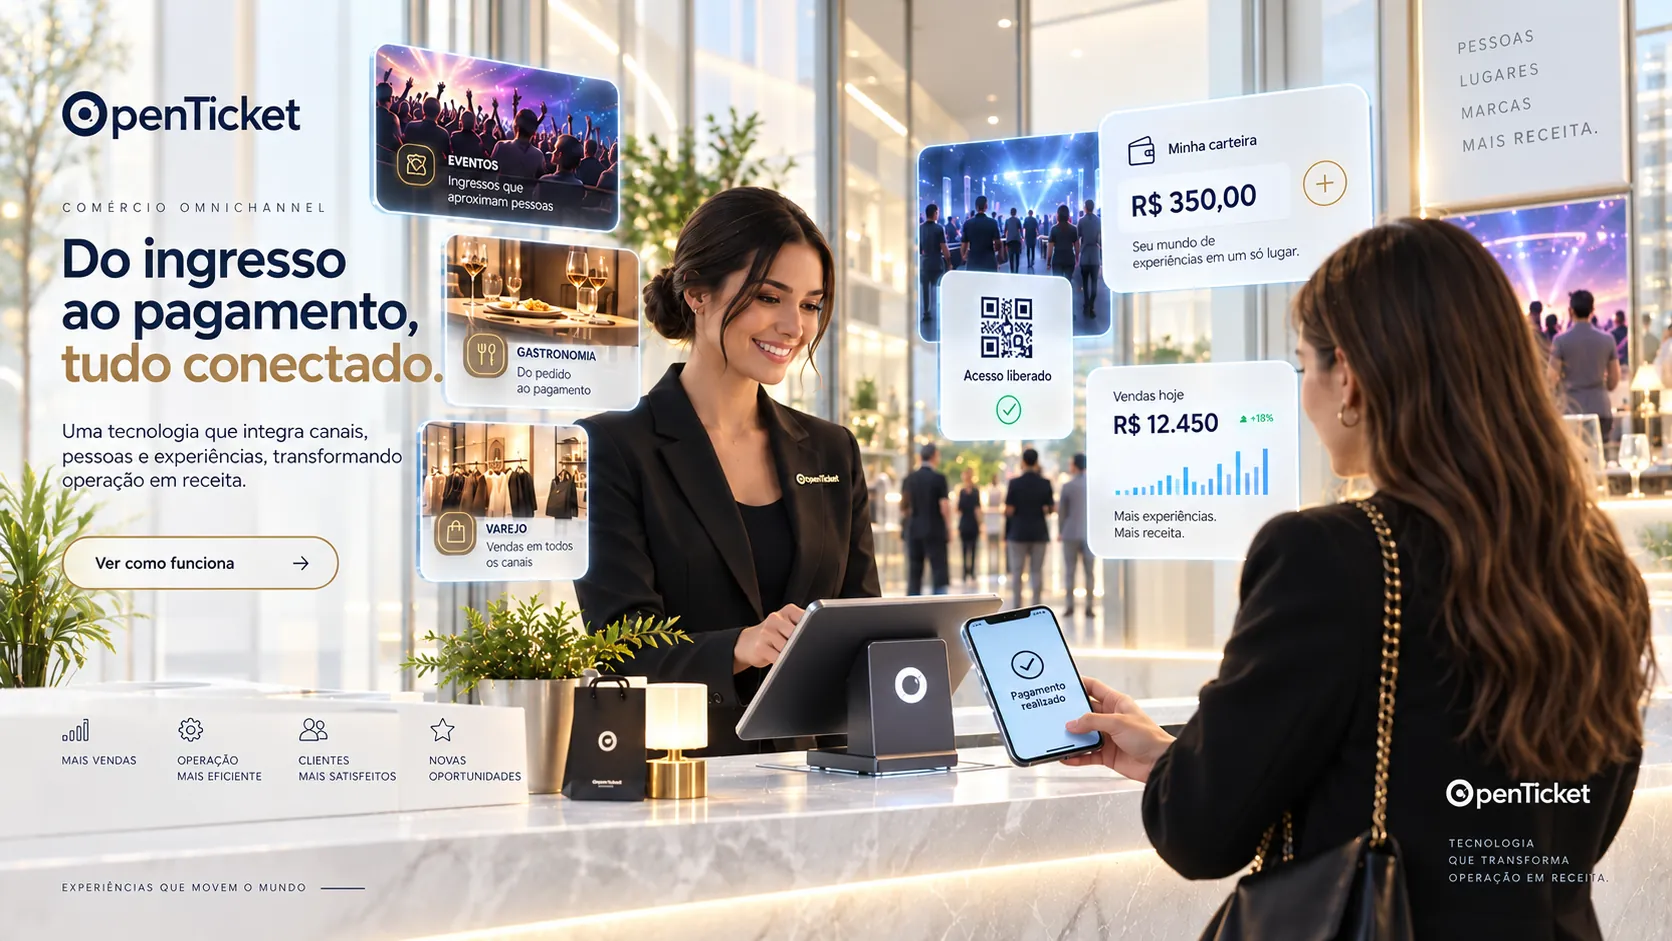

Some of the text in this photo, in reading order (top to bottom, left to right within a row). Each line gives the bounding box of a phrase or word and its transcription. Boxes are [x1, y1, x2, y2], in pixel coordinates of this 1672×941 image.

[1458, 29, 1535, 55] PESSOAS
[1460, 63, 1539, 87] LUGARES
[1461, 97, 1532, 120] MARCAS
[1462, 122, 1598, 153] MAIS RECEITA.
[1010, 682, 1066, 701] Pagamento
